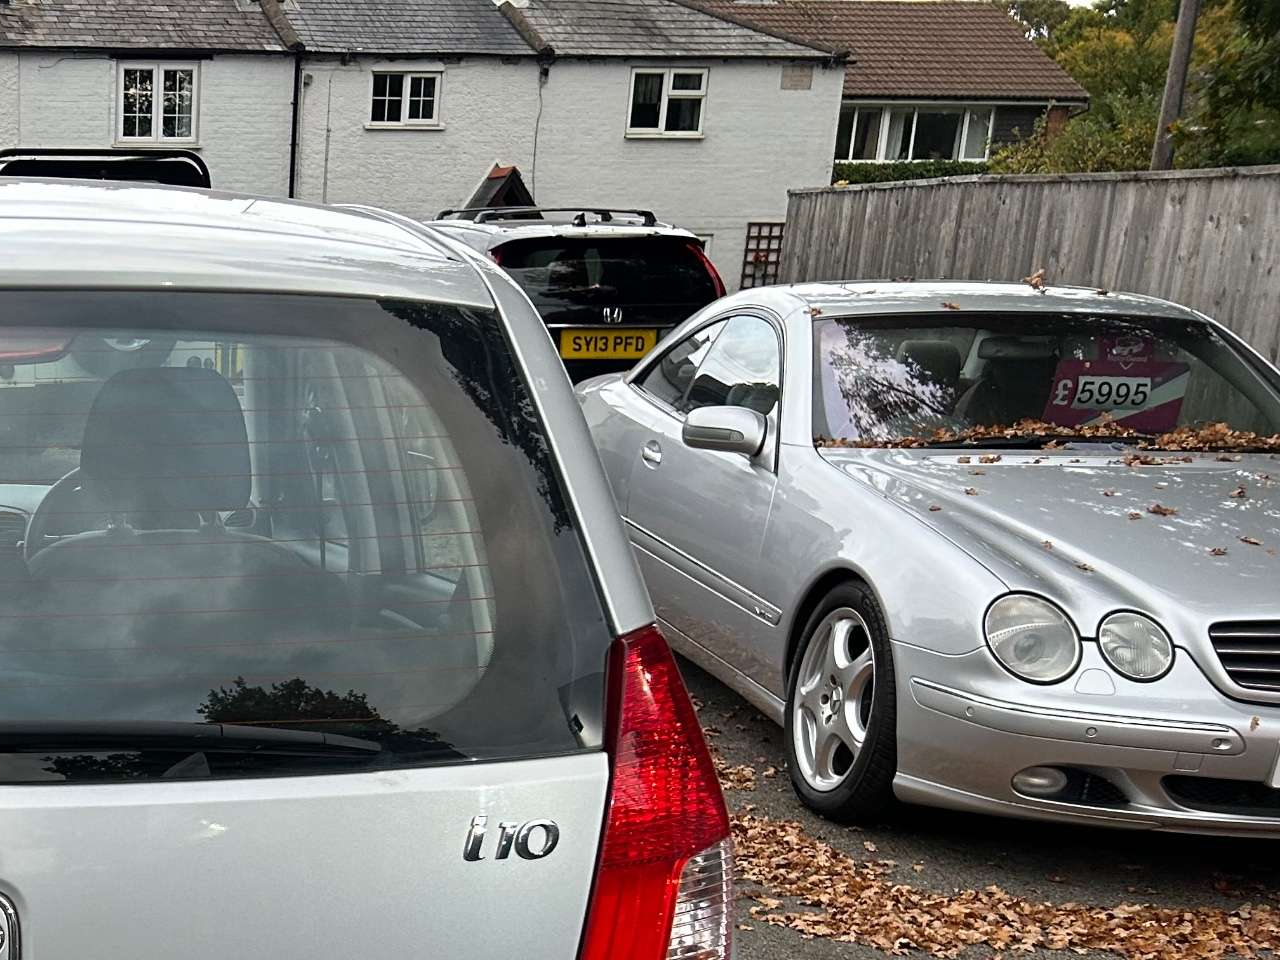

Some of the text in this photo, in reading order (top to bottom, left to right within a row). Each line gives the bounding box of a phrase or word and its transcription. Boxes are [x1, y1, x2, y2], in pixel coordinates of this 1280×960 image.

[573, 336, 645, 352] SY13 PFD
[462, 816, 560, 861] i10
